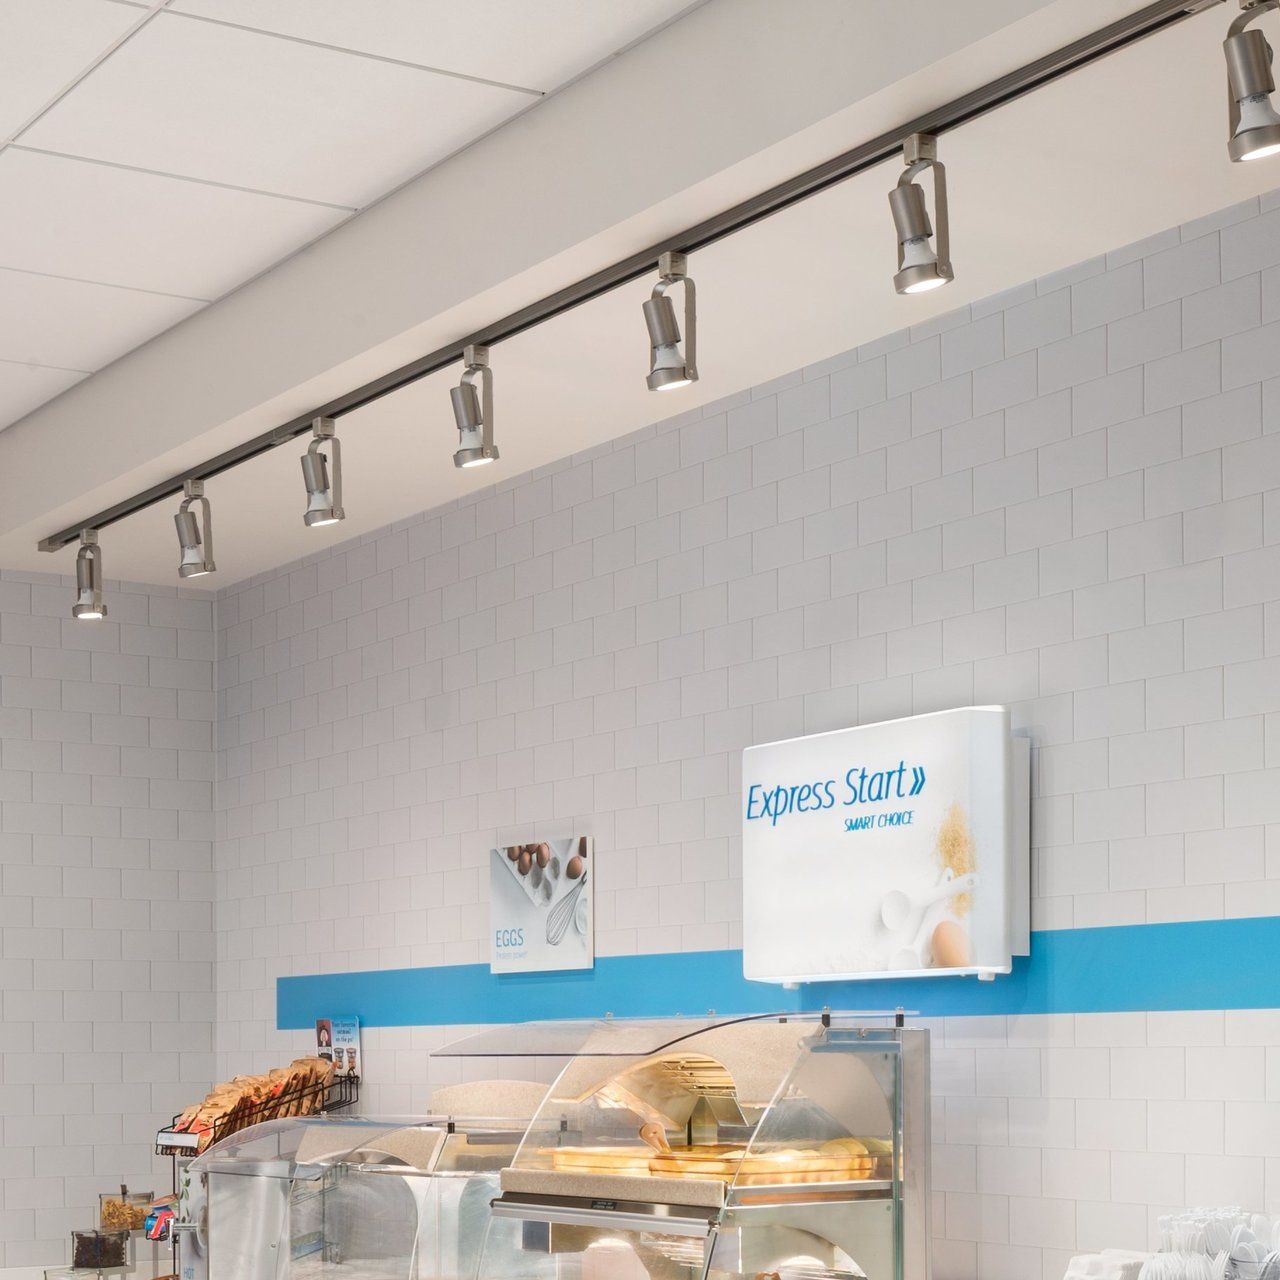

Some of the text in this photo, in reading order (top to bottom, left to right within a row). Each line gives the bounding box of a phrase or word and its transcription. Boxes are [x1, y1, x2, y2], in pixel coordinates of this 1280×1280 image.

[746, 779, 836, 827] Express
[843, 810, 915, 832] SMART CHOICE
[495, 928, 524, 948] EGGS
[183, 1267, 195, 1279] HOT
